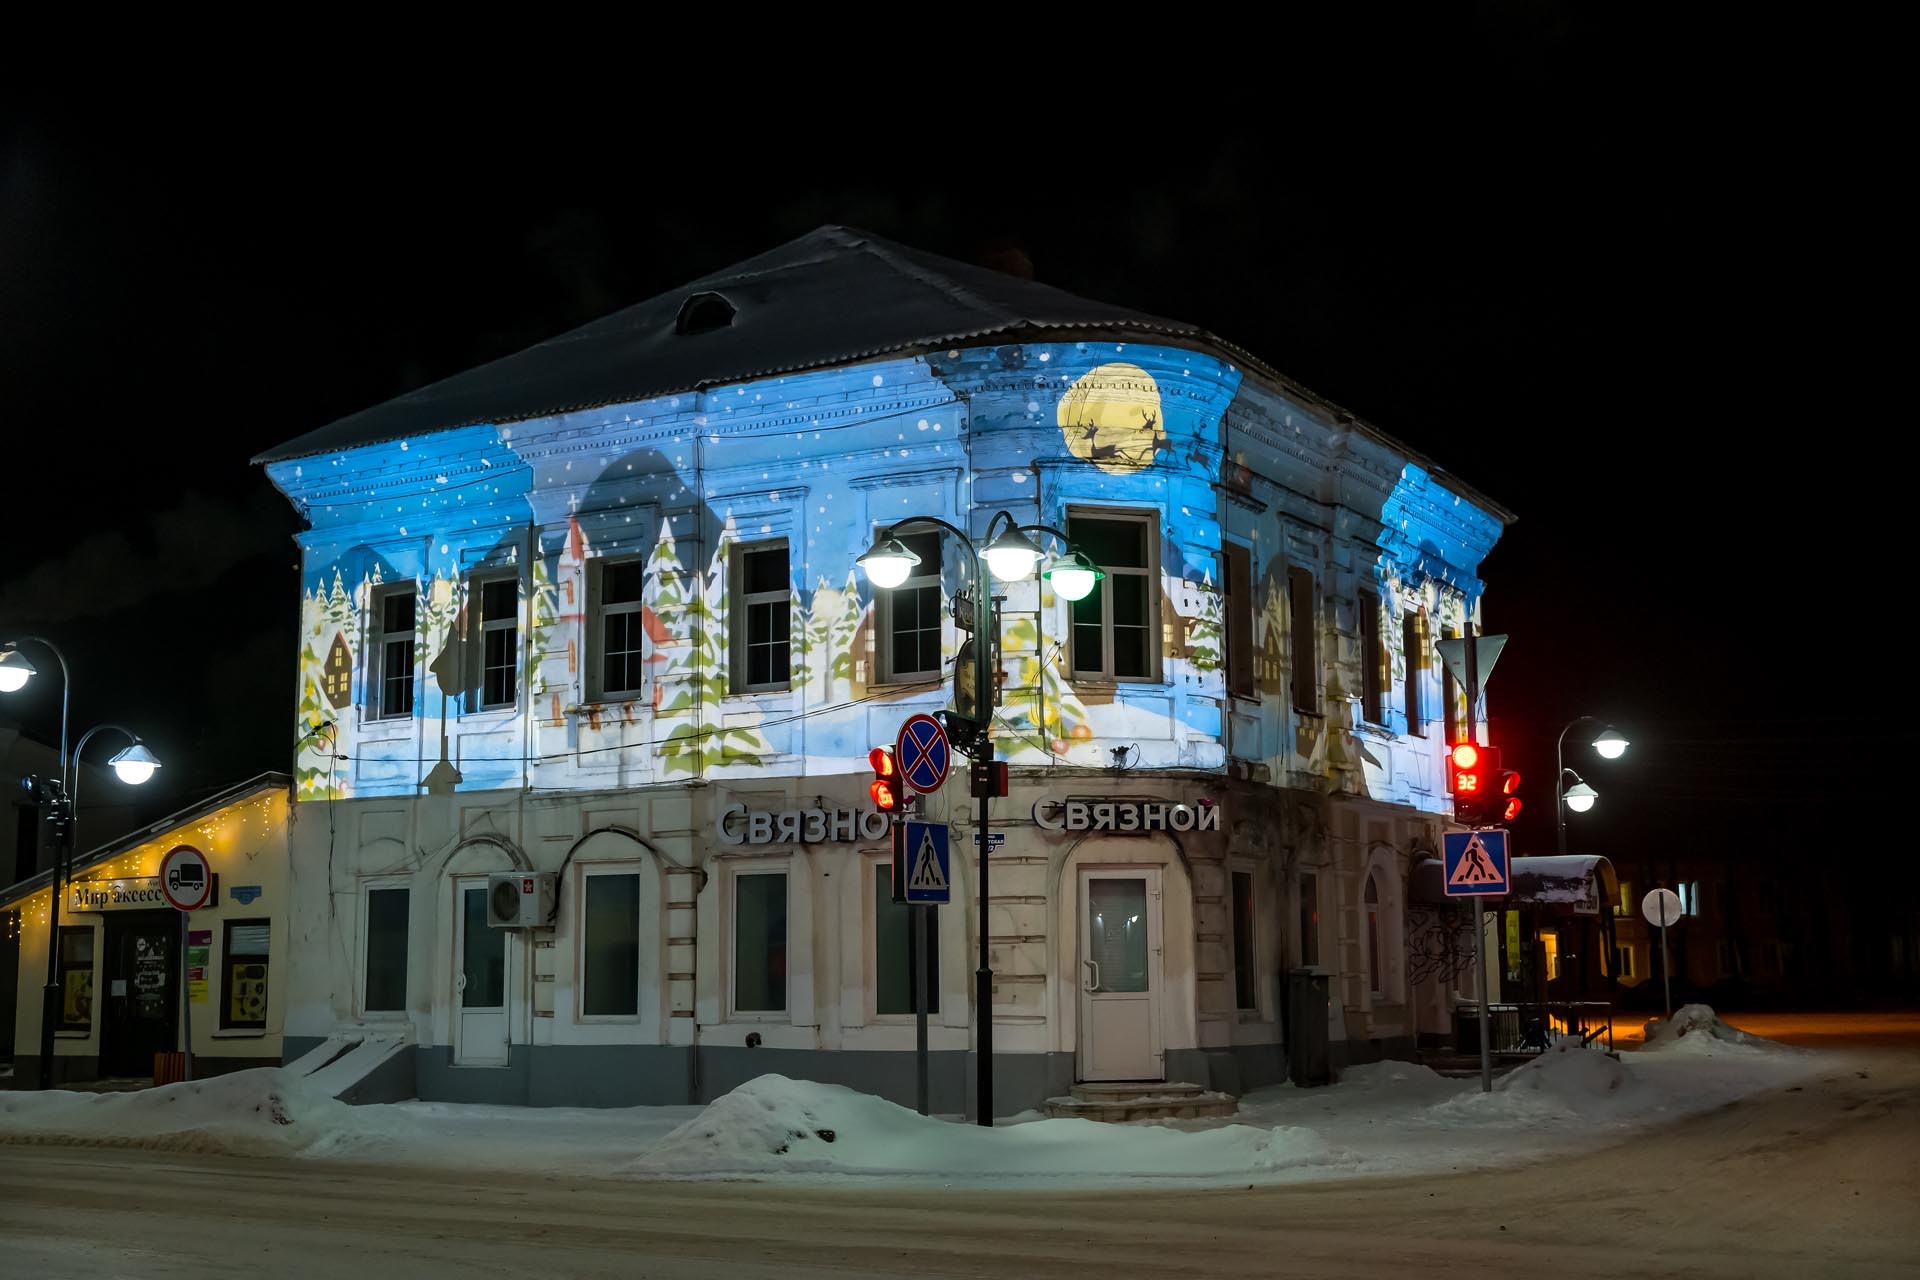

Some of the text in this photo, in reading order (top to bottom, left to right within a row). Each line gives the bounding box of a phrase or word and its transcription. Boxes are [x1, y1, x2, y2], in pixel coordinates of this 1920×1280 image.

[1457, 774, 1477, 791] 32
[716, 802, 908, 845] Связно
[75, 888, 166, 908] Мир аксесс
